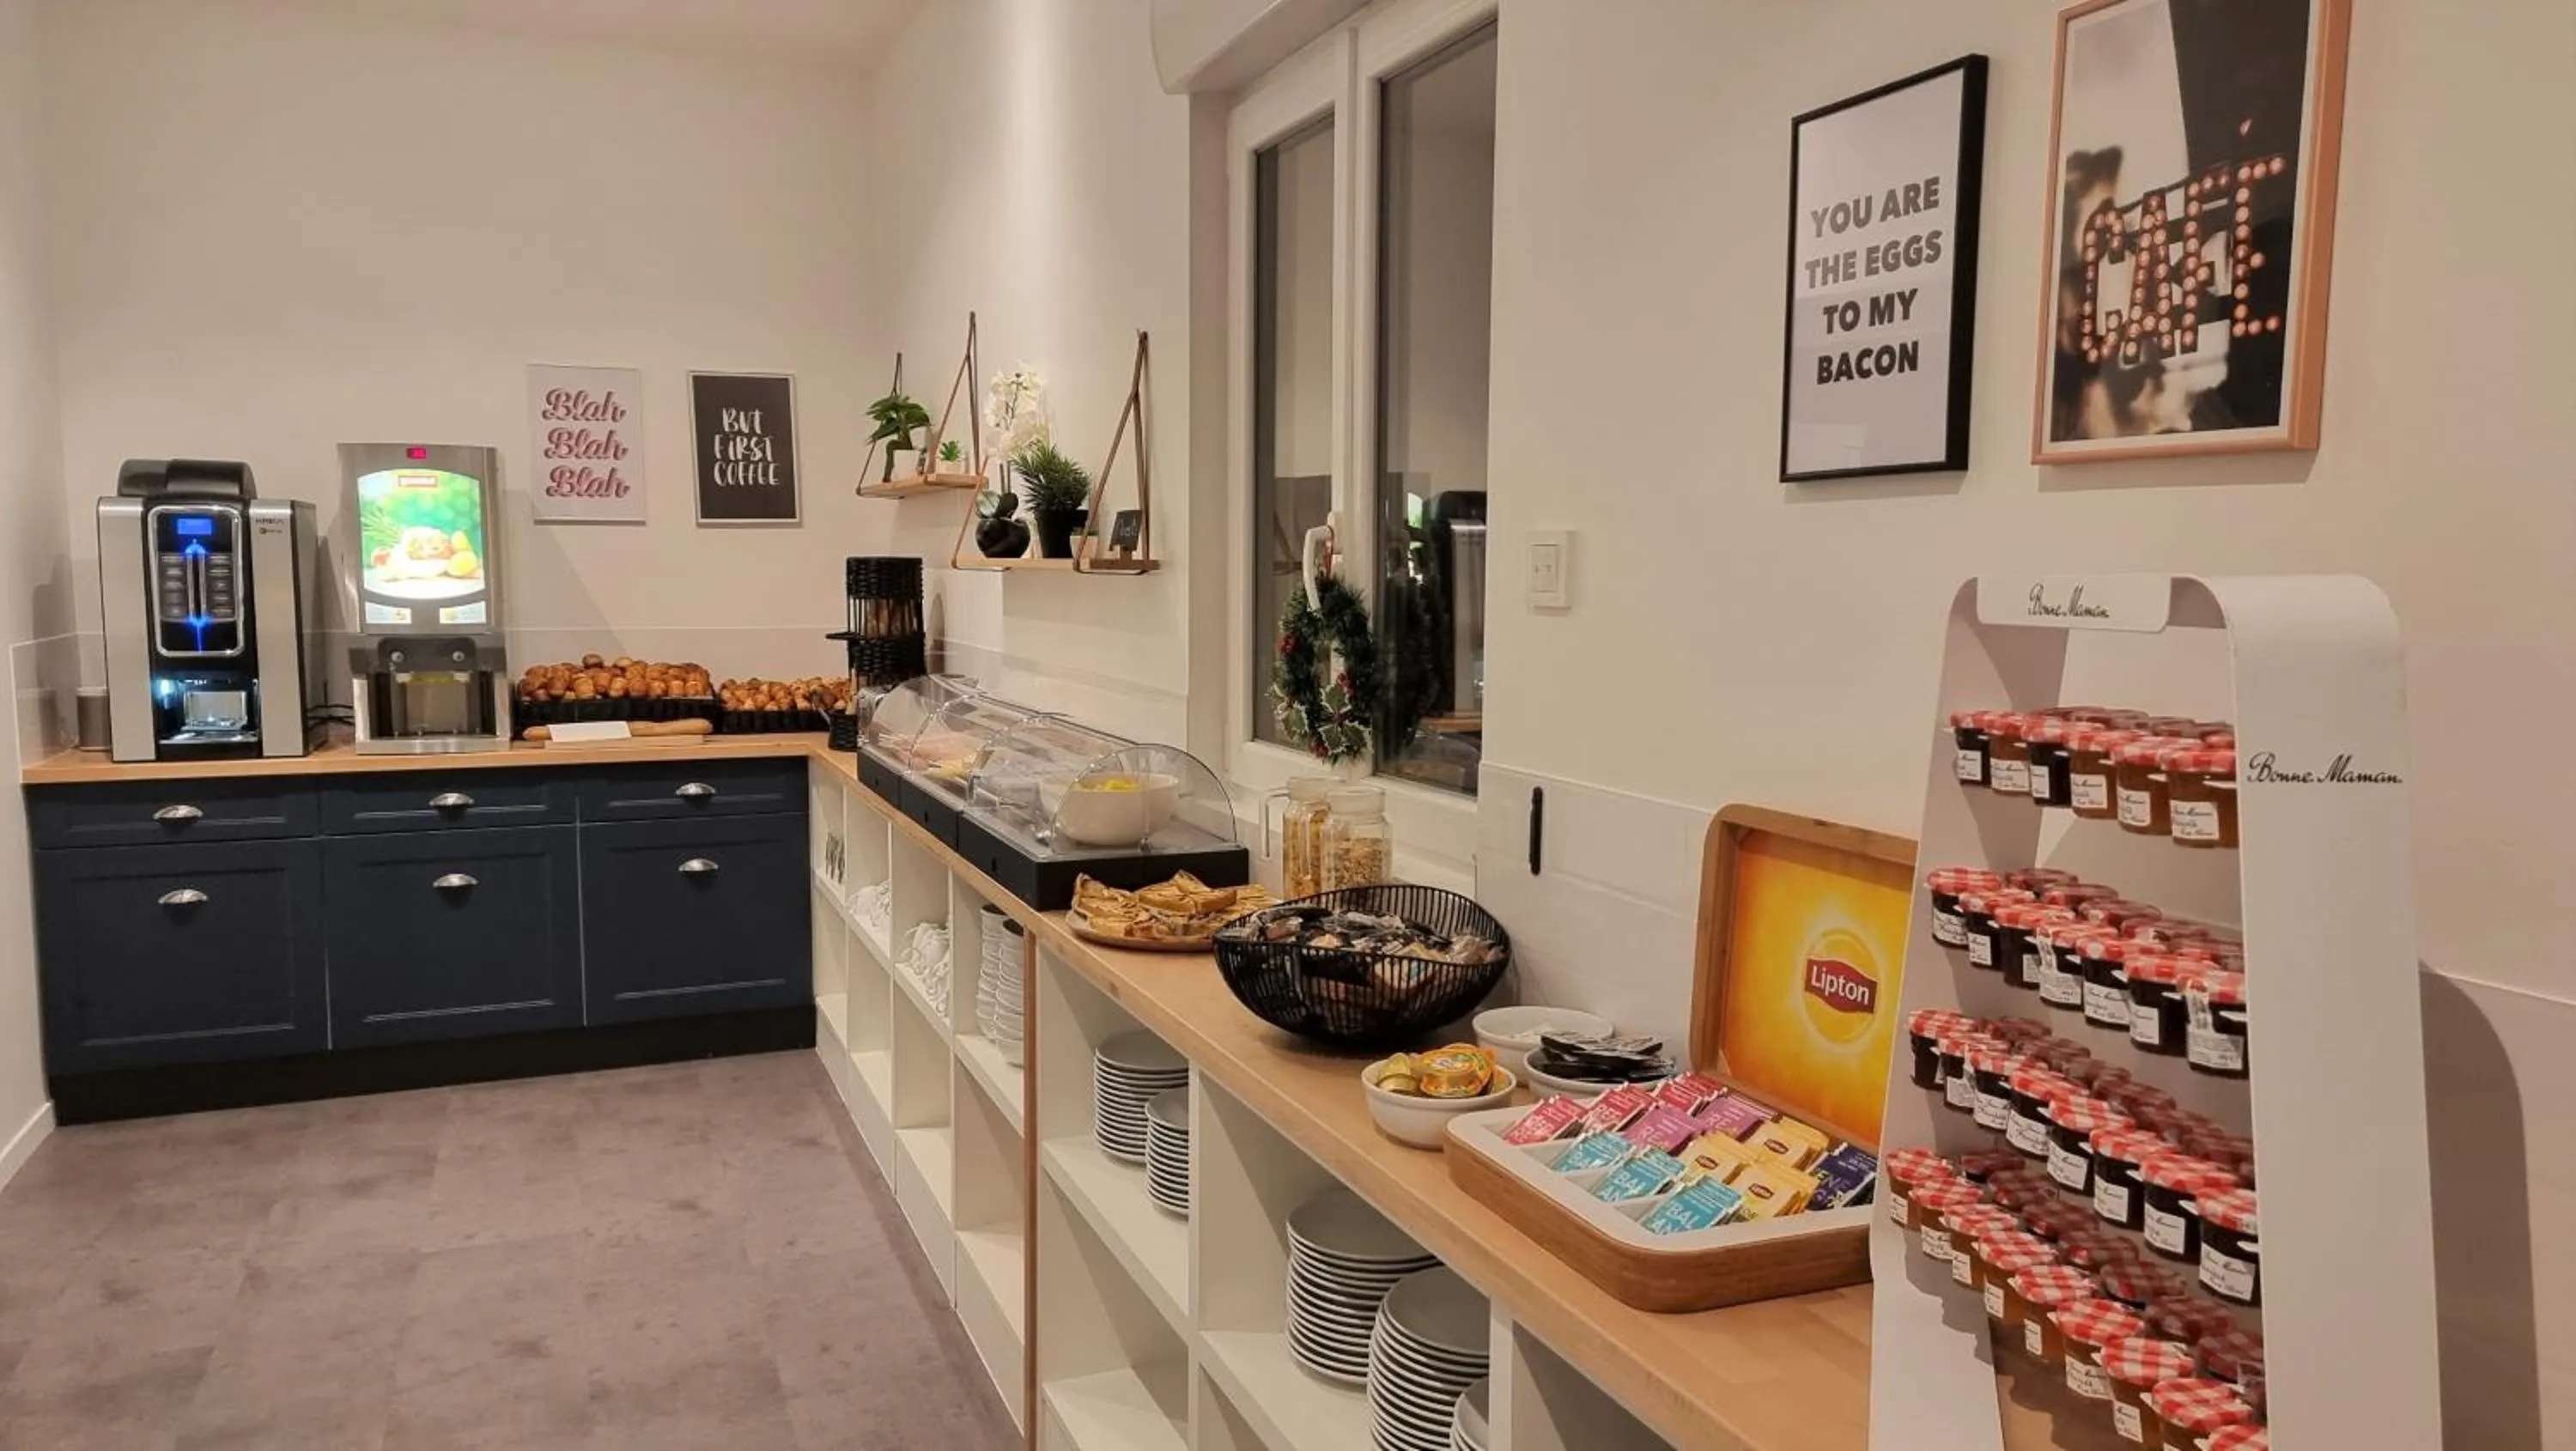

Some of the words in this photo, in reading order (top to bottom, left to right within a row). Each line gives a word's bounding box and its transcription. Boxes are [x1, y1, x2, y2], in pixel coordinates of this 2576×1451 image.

[1810, 195, 1874, 239] YOU
[1879, 176, 1941, 211] ARE
[1804, 256, 1857, 289] THE
[1863, 228, 1943, 277] EGGS
[1822, 301, 1862, 335] TO
[1868, 287, 1919, 329] MY
[1815, 340, 1920, 386] BACON
[541, 387, 627, 423] Blah
[721, 406, 763, 434] BUT
[543, 427, 629, 461] Blah
[544, 464, 631, 499] Blah
[713, 460, 781, 488] COFFEE
[2027, 583, 2063, 616] Bonne
[2067, 583, 2110, 617] Maman
[2246, 750, 2314, 783] Bonne
[2317, 752, 2403, 784] Maman
[1810, 964, 1870, 1005] Lipton
